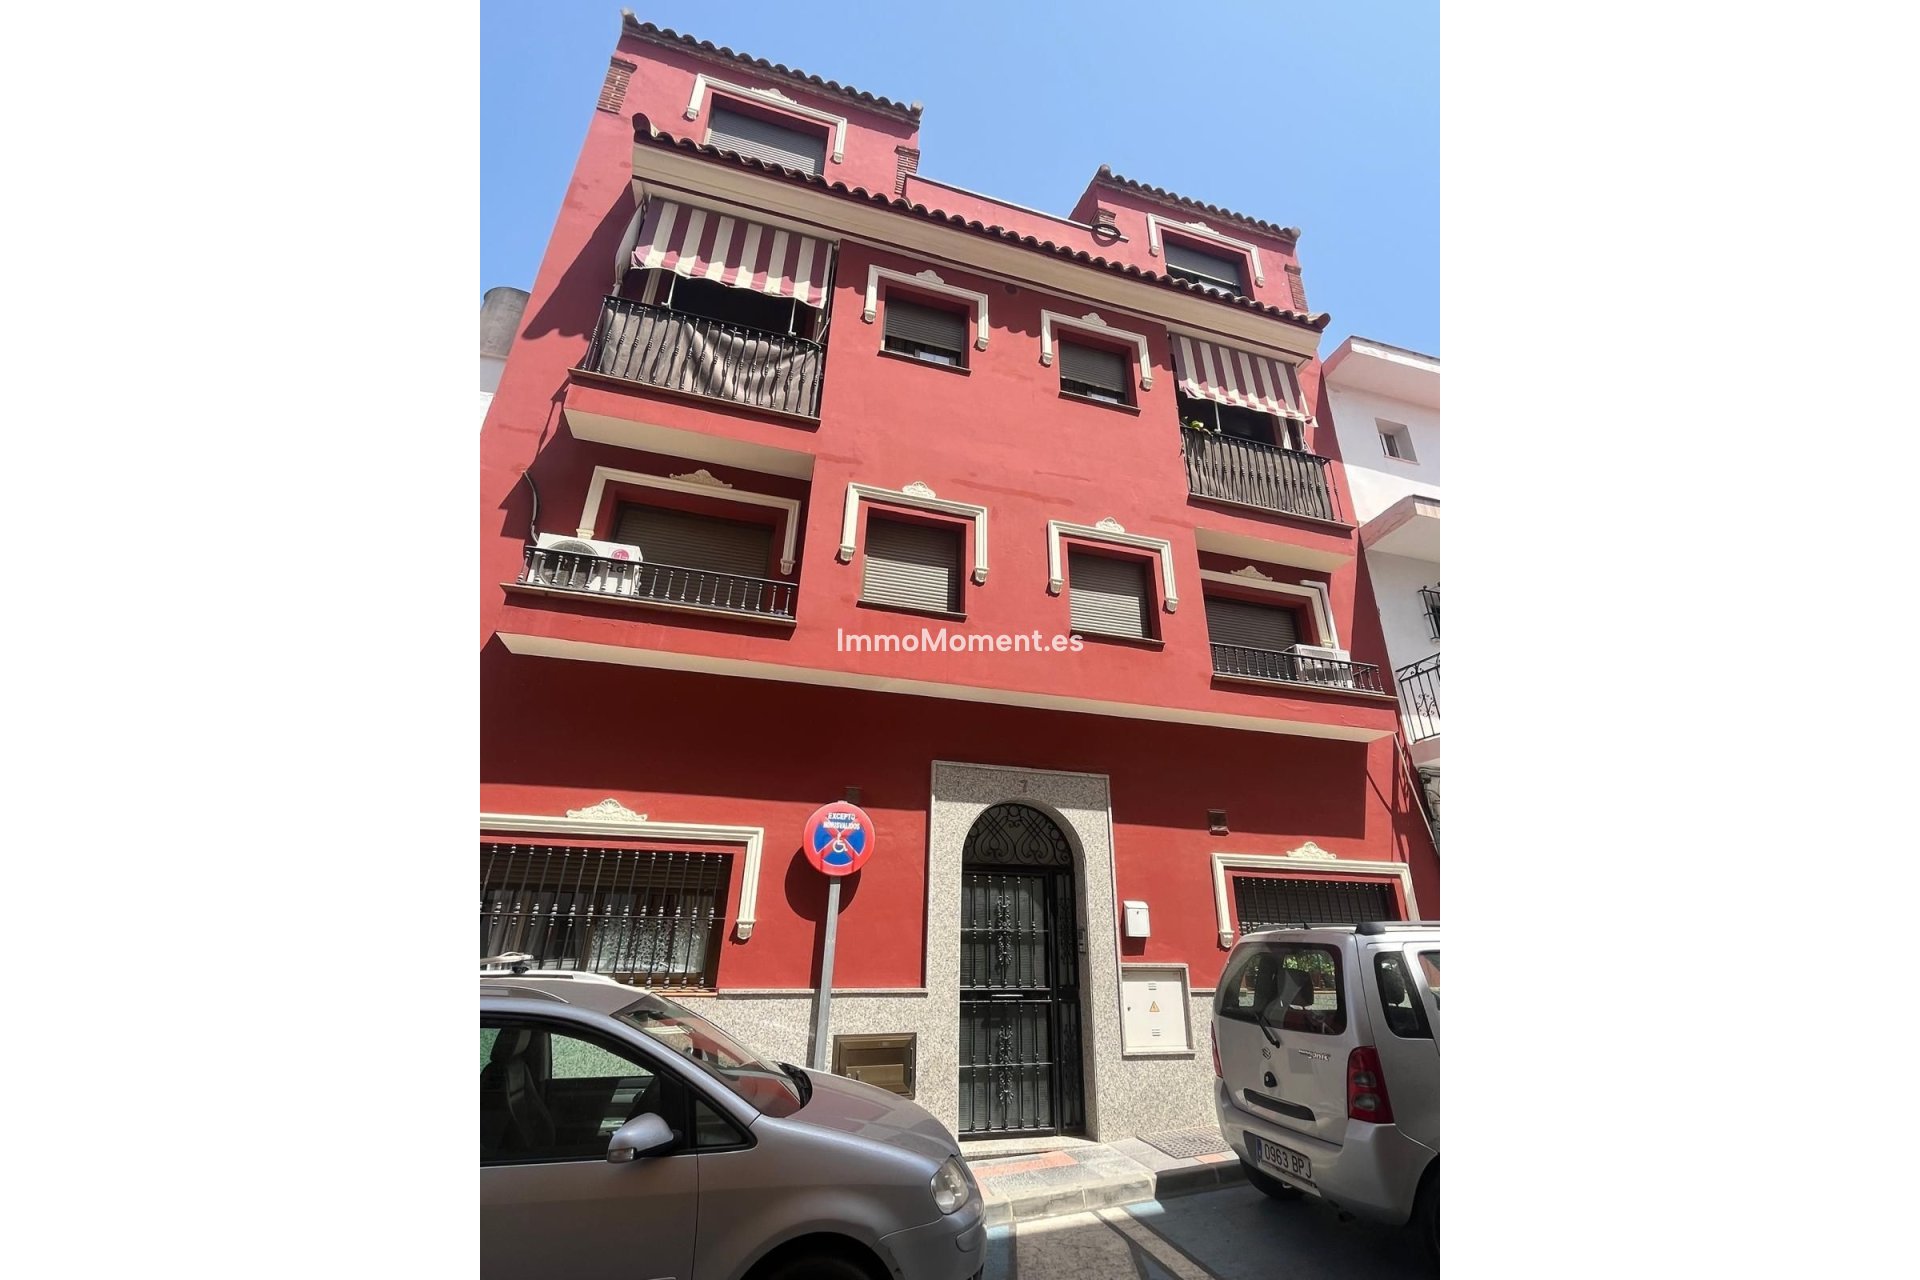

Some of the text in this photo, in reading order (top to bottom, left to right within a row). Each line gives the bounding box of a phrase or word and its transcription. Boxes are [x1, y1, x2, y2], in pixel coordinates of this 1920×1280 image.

[828, 812, 856, 820] EXCEPTO
[1264, 1143, 1312, 1179] 0963 BPJ
